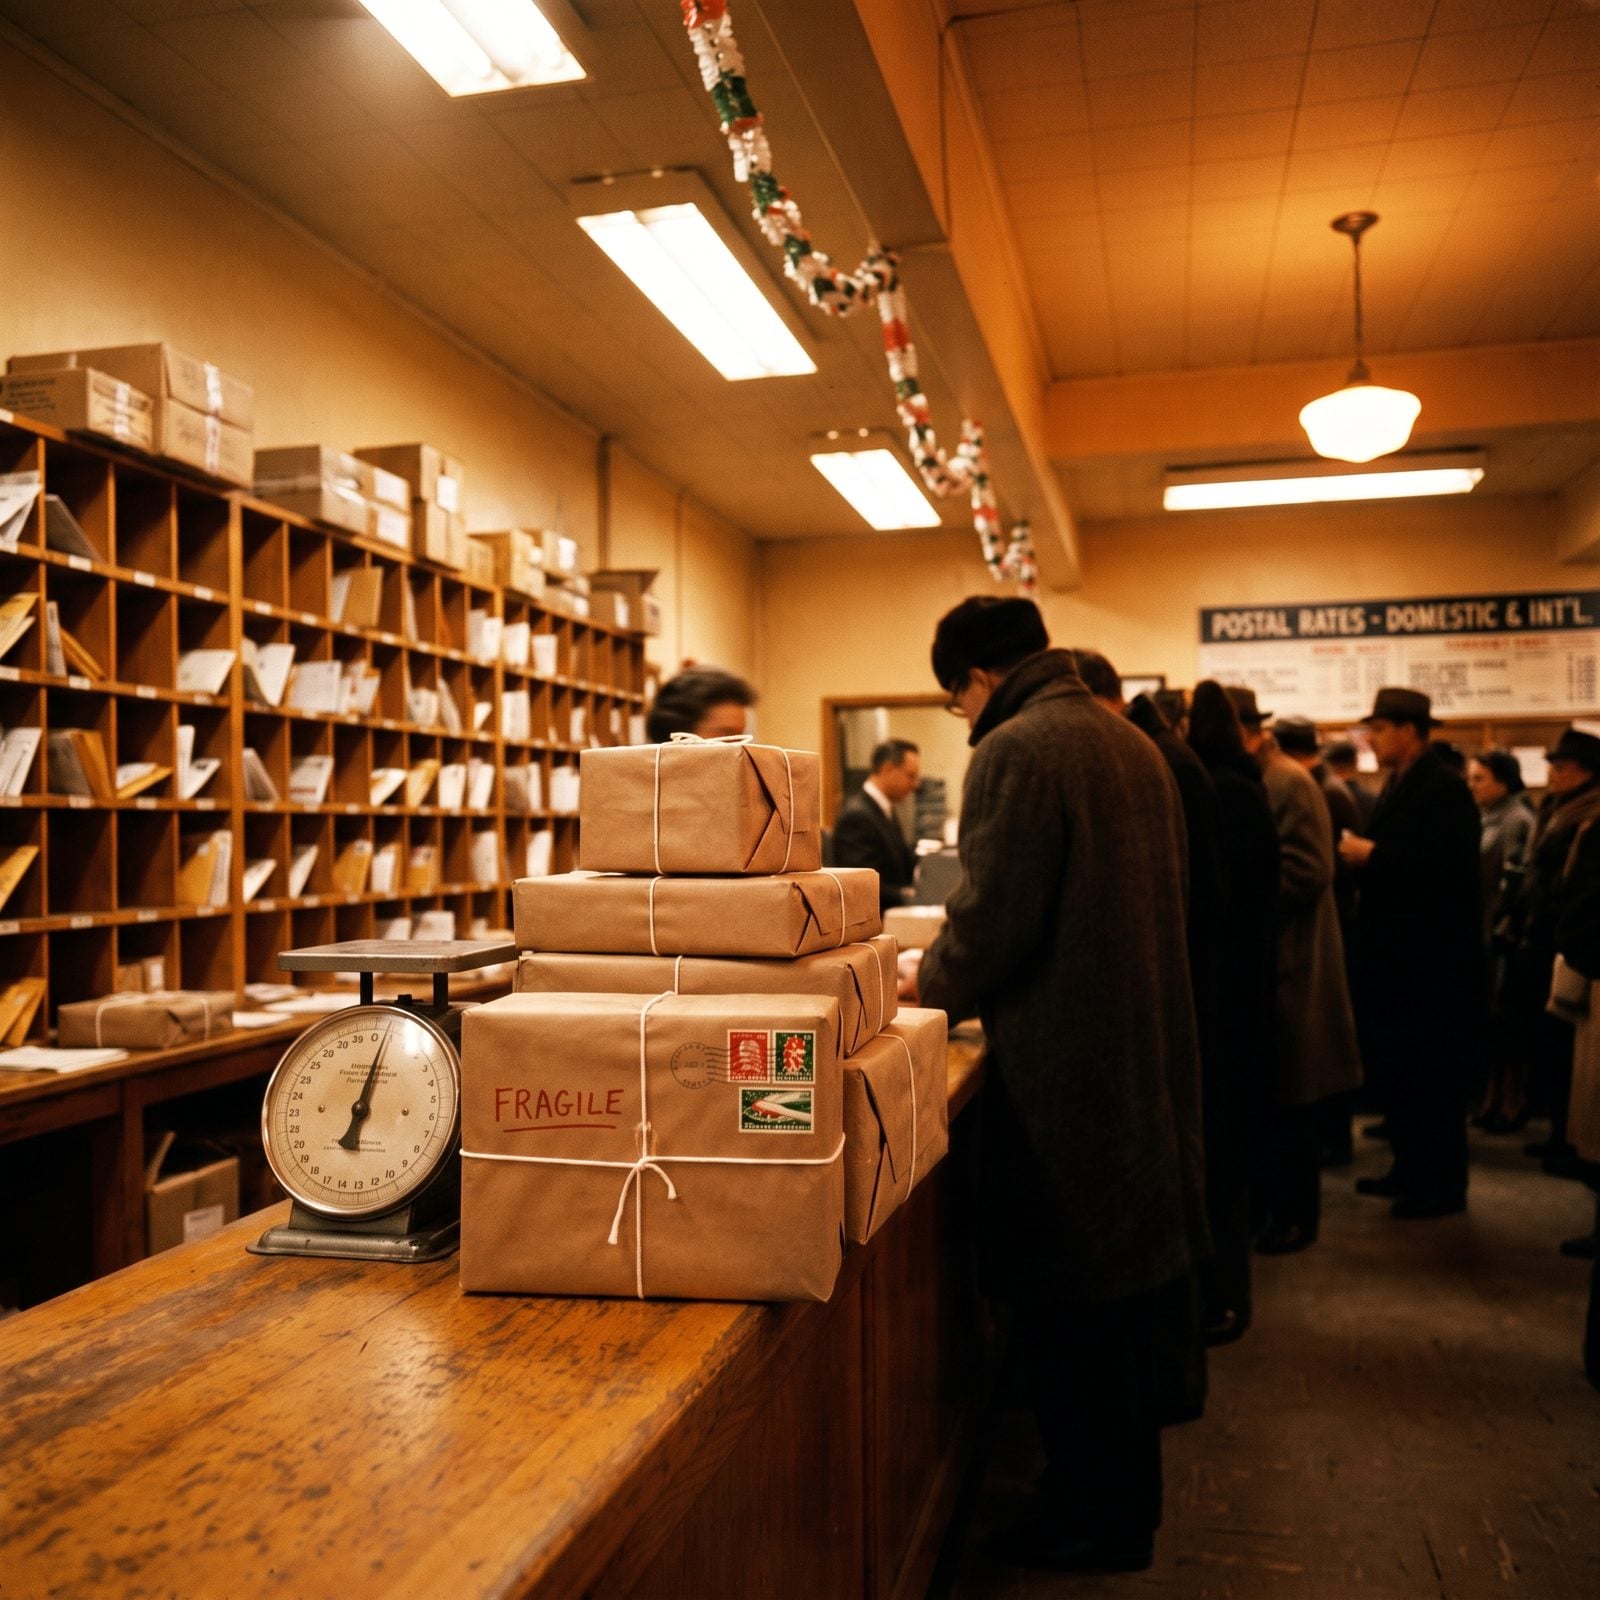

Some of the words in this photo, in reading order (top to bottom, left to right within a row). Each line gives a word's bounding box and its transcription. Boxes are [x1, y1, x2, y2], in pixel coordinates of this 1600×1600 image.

[1211, 610, 1292, 639] POSTAL
[1297, 606, 1366, 635] RATES
[1385, 601, 1498, 632] DOMESTIC
[1506, 600, 1523, 628] &
[371, 1033, 378, 1042] 0
[337, 1041, 348, 1049] 20
[323, 1049, 334, 1058] 20
[427, 1079, 434, 1087] 4
[292, 1092, 303, 1100] 24
[430, 1095, 436, 1103] 5
[495, 1088, 624, 1122] FRAGILE
[289, 1109, 300, 1117] 23
[429, 1113, 435, 1121] 6
[424, 1130, 430, 1139] 7
[293, 1140, 305, 1149] 20
[413, 1145, 420, 1153] 8
[300, 1154, 309, 1163] 19
[402, 1159, 408, 1168] 9
[310, 1166, 319, 1175] 18
[385, 1170, 395, 1178] 10
[323, 1176, 332, 1184] 17
[337, 1180, 347, 1188] 14
[370, 1177, 380, 1185] 12
[354, 1181, 364, 1189] 13
